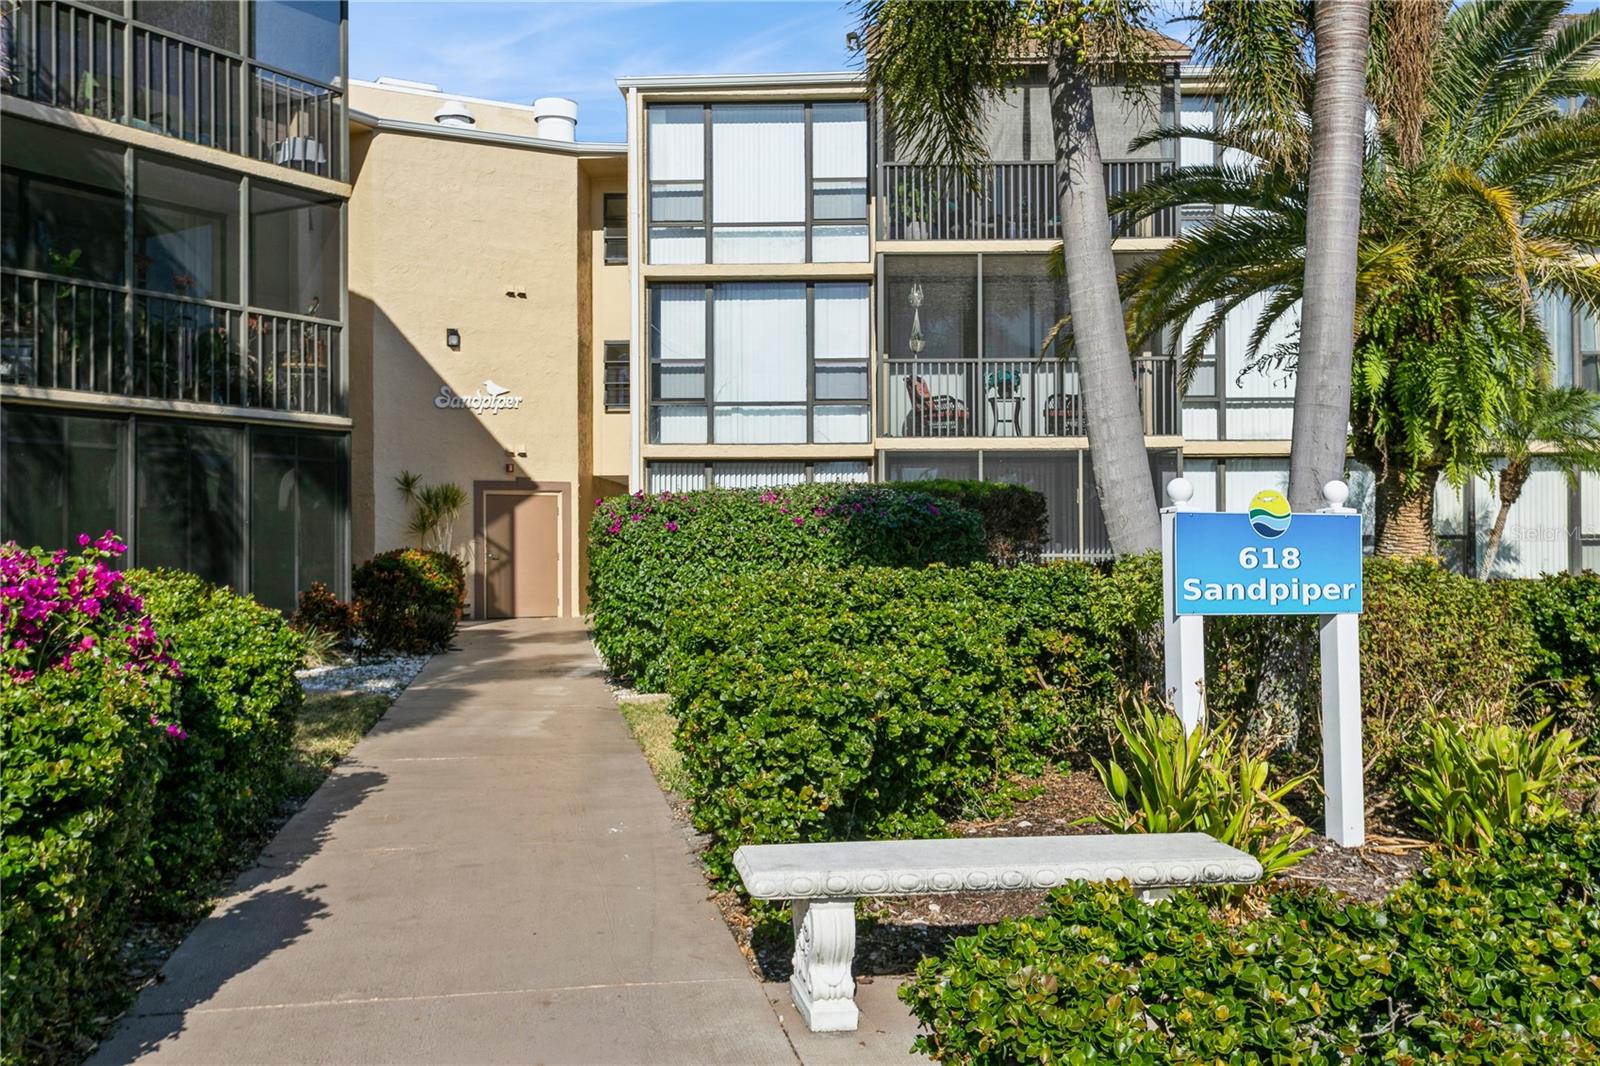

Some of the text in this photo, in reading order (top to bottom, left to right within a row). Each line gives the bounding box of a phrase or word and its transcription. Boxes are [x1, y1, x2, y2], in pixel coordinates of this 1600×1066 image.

[434, 385, 522, 415] Sandpiper
[1239, 547, 1301, 570] 618
[1183, 577, 1356, 606] Sandpiper
